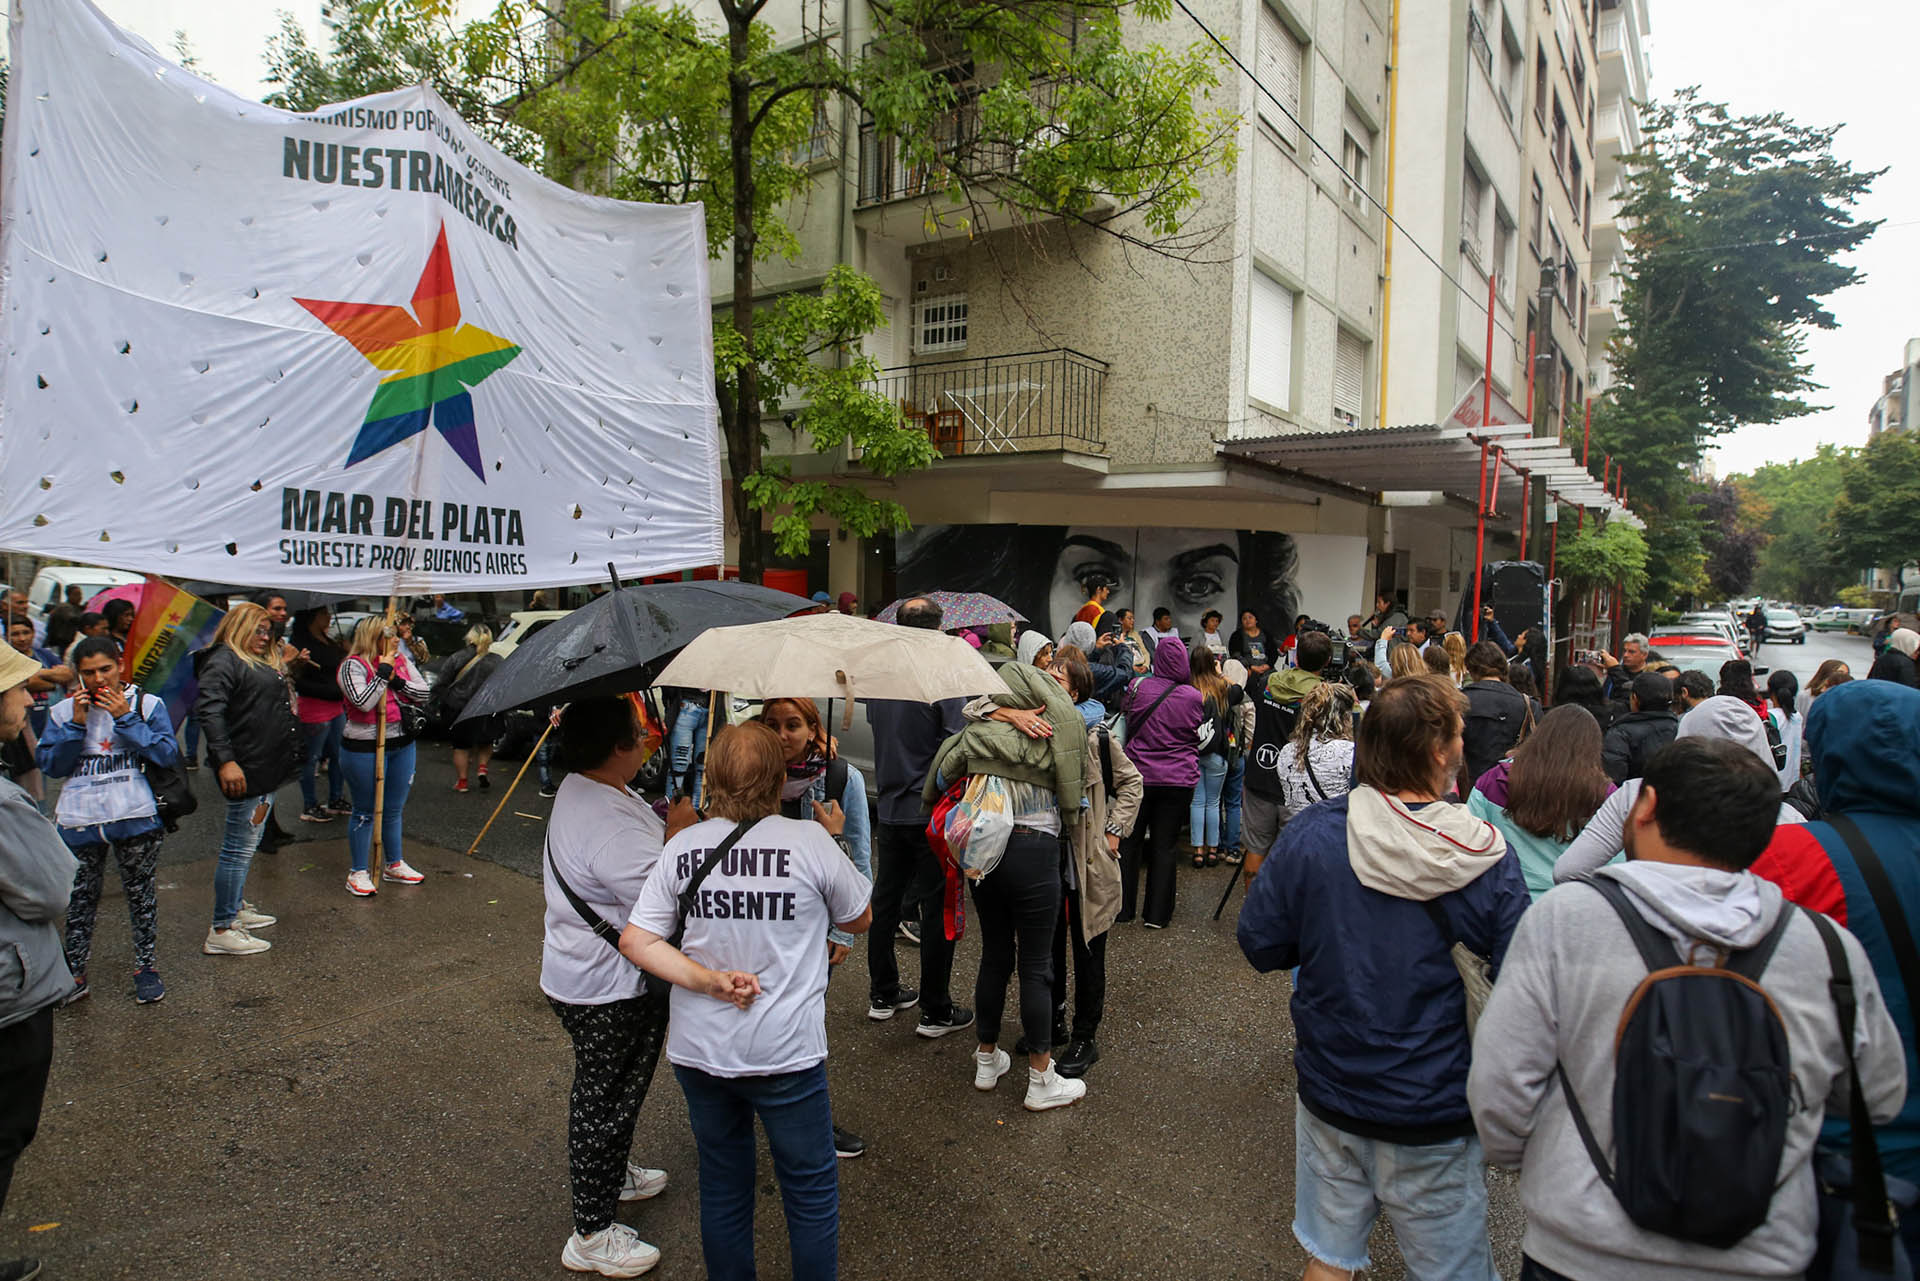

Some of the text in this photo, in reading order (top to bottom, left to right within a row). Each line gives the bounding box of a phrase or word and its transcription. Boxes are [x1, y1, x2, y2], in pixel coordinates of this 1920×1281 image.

[281, 487, 525, 546] MAR DEL PLATA
[279, 539, 365, 568] SURESTE
[423, 548, 481, 574] BUENOS
[486, 552, 528, 575] AIRES
[1260, 748, 1279, 764] TV
[688, 890, 796, 921] RESENTE
